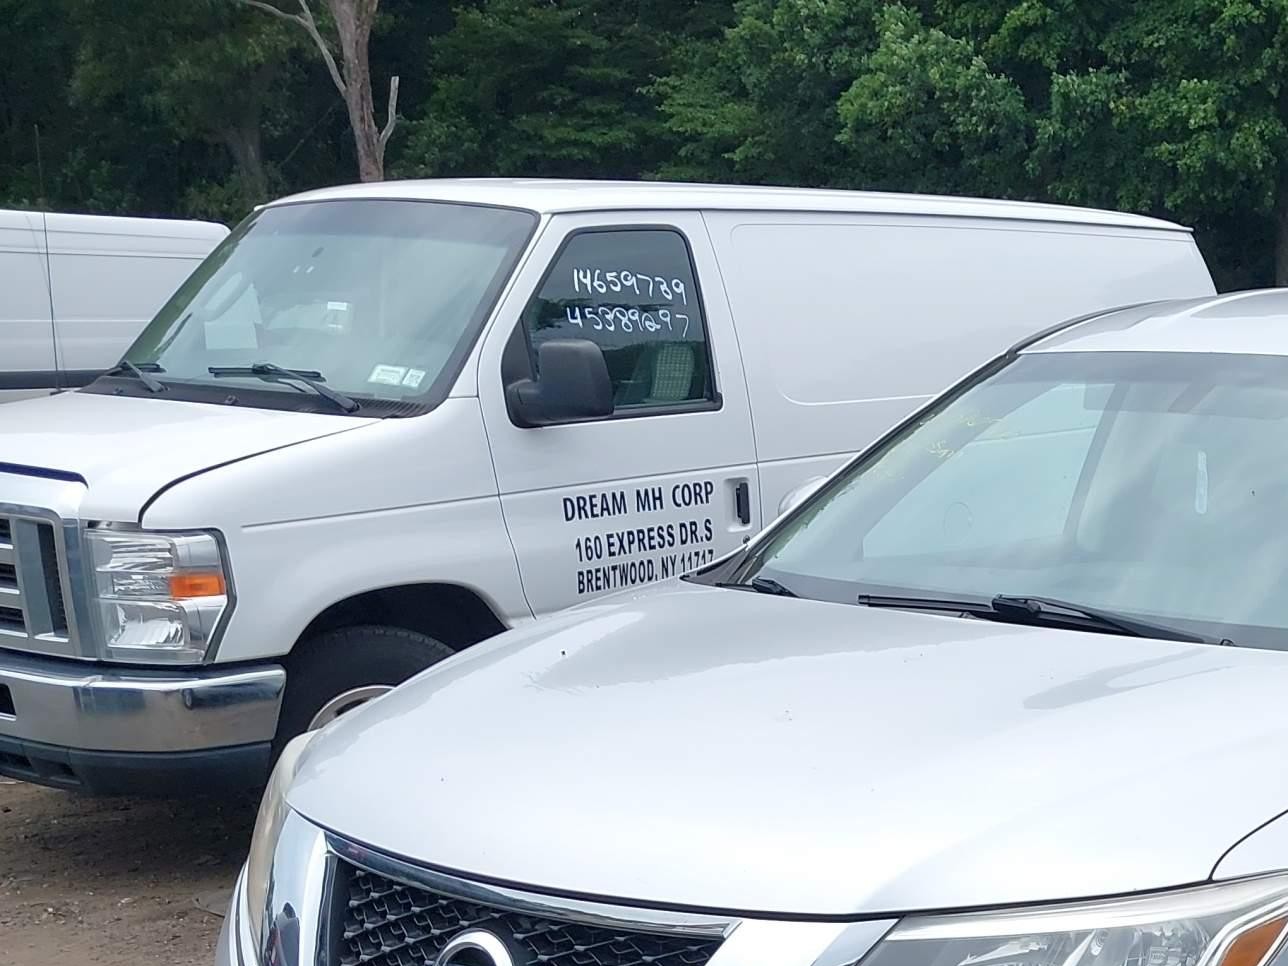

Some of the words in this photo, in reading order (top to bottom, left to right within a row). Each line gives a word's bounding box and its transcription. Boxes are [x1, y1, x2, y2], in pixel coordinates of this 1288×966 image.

[562, 490, 628, 522] DREAM
[635, 486, 664, 513] MH
[672, 480, 714, 508] CORP
[575, 535, 603, 562] 160
[606, 523, 676, 557] EXPRESS
[679, 518, 713, 546] DR.S
[661, 554, 677, 580] NY
